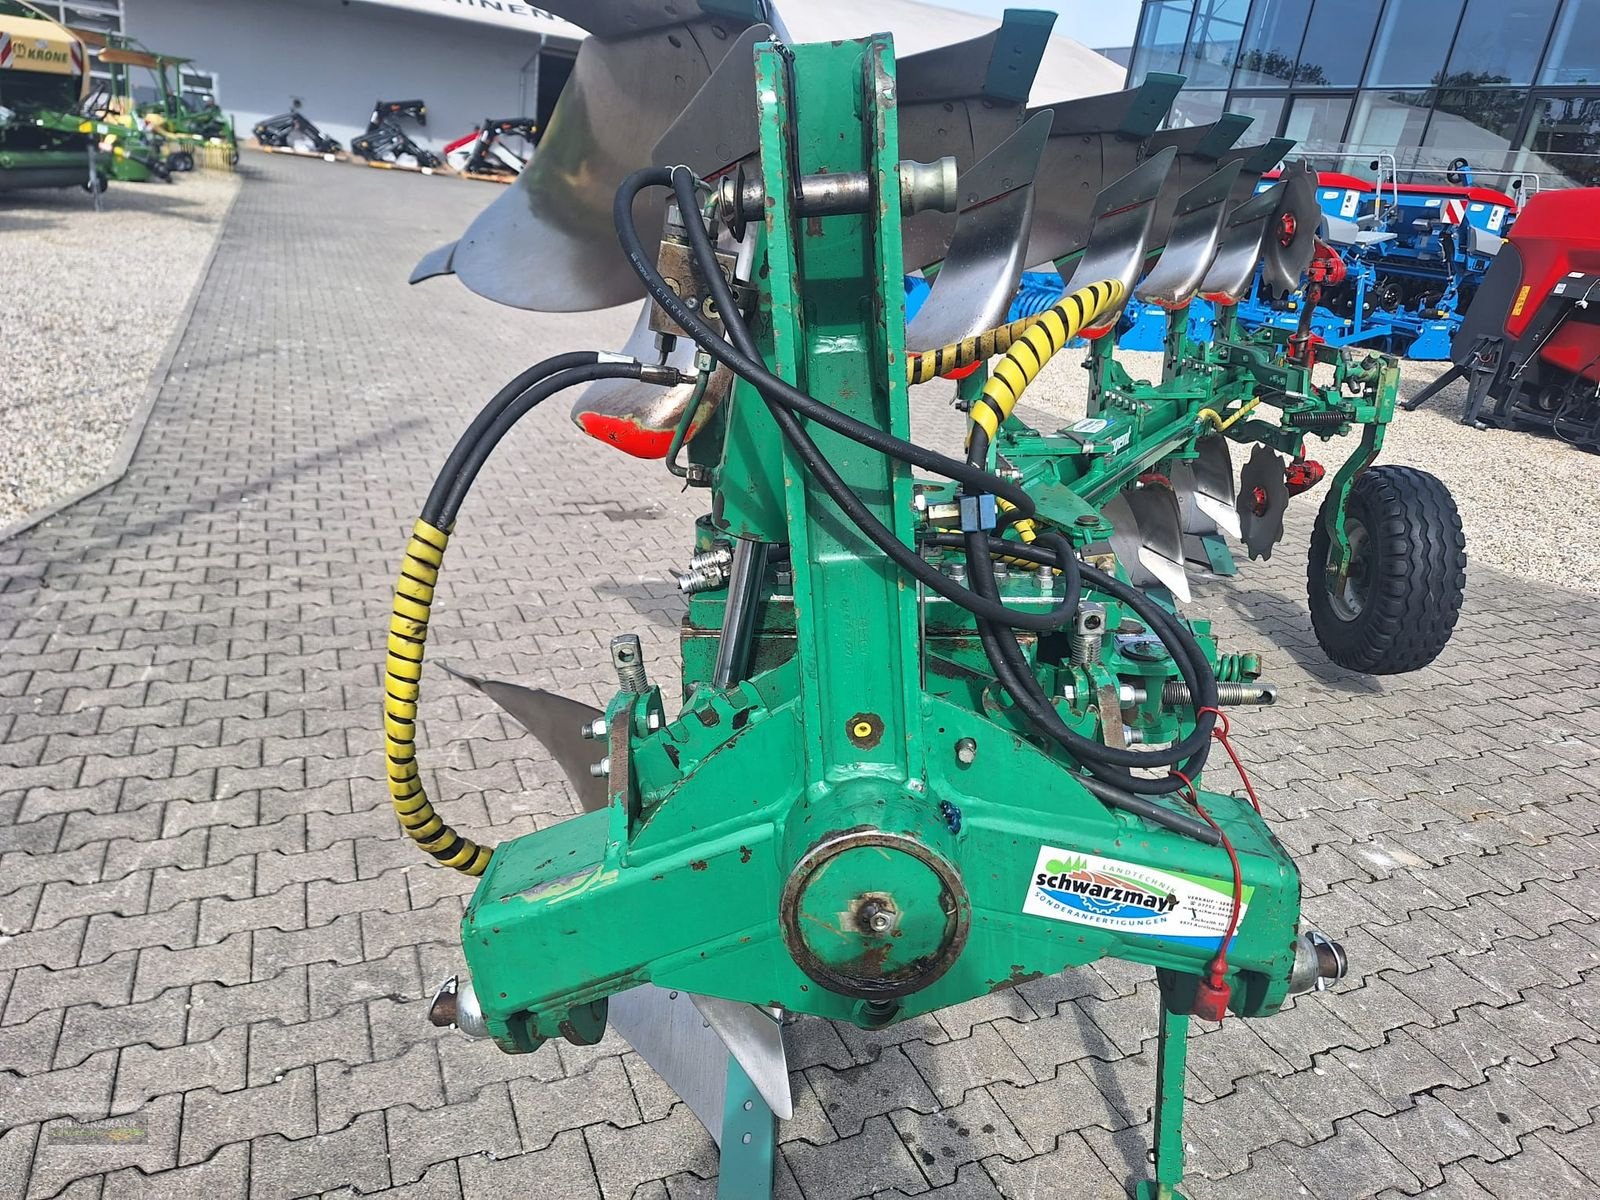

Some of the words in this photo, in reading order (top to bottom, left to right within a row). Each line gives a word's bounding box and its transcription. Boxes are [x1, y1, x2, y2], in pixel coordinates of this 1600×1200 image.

[27, 48, 69, 63] KRONE
[1036, 873, 1180, 912] schwarzmayr
[1102, 864, 1177, 894] LANDTECHNIK
[1034, 891, 1168, 926] SONDERANFERTIGUNGEN
